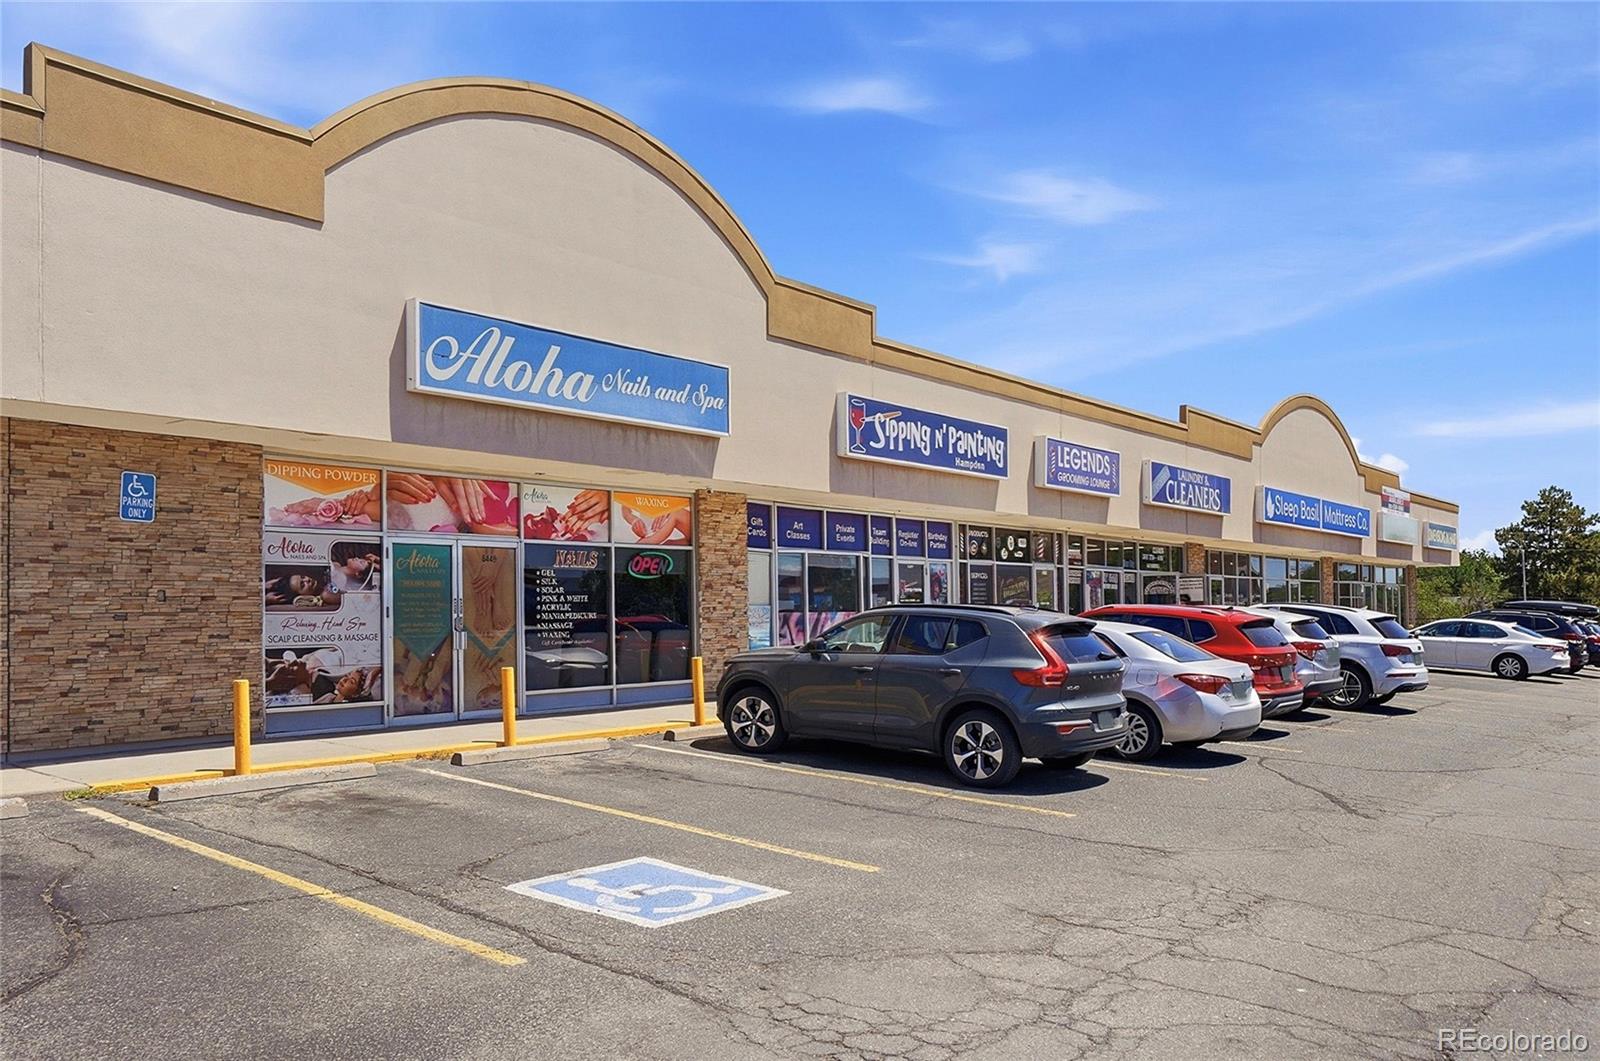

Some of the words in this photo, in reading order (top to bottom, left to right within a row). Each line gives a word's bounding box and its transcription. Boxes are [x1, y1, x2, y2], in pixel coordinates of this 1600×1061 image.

[425, 326, 598, 403] Aloha
[602, 368, 650, 398] Nails
[654, 383, 689, 404] and
[692, 383, 725, 415] Spa
[955, 457, 985, 471] Hampden
[1057, 445, 1111, 476] LEGENDS
[267, 463, 321, 479] DIPPING
[324, 469, 377, 484] POWDER
[1177, 469, 1204, 485] LAUNDRY
[1204, 475, 1211, 487] &
[1057, 471, 1090, 486] GROOMING
[1090, 477, 1111, 489] LOUNGE
[1166, 479, 1221, 511] CLEANERS
[122, 496, 153, 508] PARKING
[635, 497, 669, 508] WAXING
[128, 507, 147, 518] ONLY
[1275, 494, 1299, 522] Sleep
[1300, 500, 1320, 521] Basil
[1324, 505, 1356, 528] Mattress
[1356, 511, 1368, 531] Co.
[750, 516, 763, 526] Gift
[793, 521, 803, 530] Art
[747, 526, 767, 537] Cards
[835, 524, 855, 533] Private
[872, 527, 886, 536] Team
[898, 529, 919, 539] Register
[786, 530, 811, 540] Classes
[836, 533, 855, 542] Events
[928, 532, 947, 542] Birthday
[268, 537, 315, 558] Aloha
[929, 541, 946, 549] Parties
[396, 549, 440, 574] Aloha
[553, 549, 599, 569] NAILS
[632, 554, 668, 575] OPEN
[541, 569, 556, 577] GEL
[540, 577, 558, 586] SILK
[541, 586, 565, 594] SOLAR
[541, 595, 558, 603] PINK
[541, 603, 572, 611] ACRYLIC
[281, 616, 317, 632] Relaxing
[320, 616, 343, 631] Head
[346, 616, 367, 631] Spa
[541, 621, 574, 629] MASSAGE
[267, 634, 292, 643] SCALP
[292, 633, 336, 643] CLEANSING
[337, 633, 343, 641] &
[344, 633, 379, 642] MASSAGE
